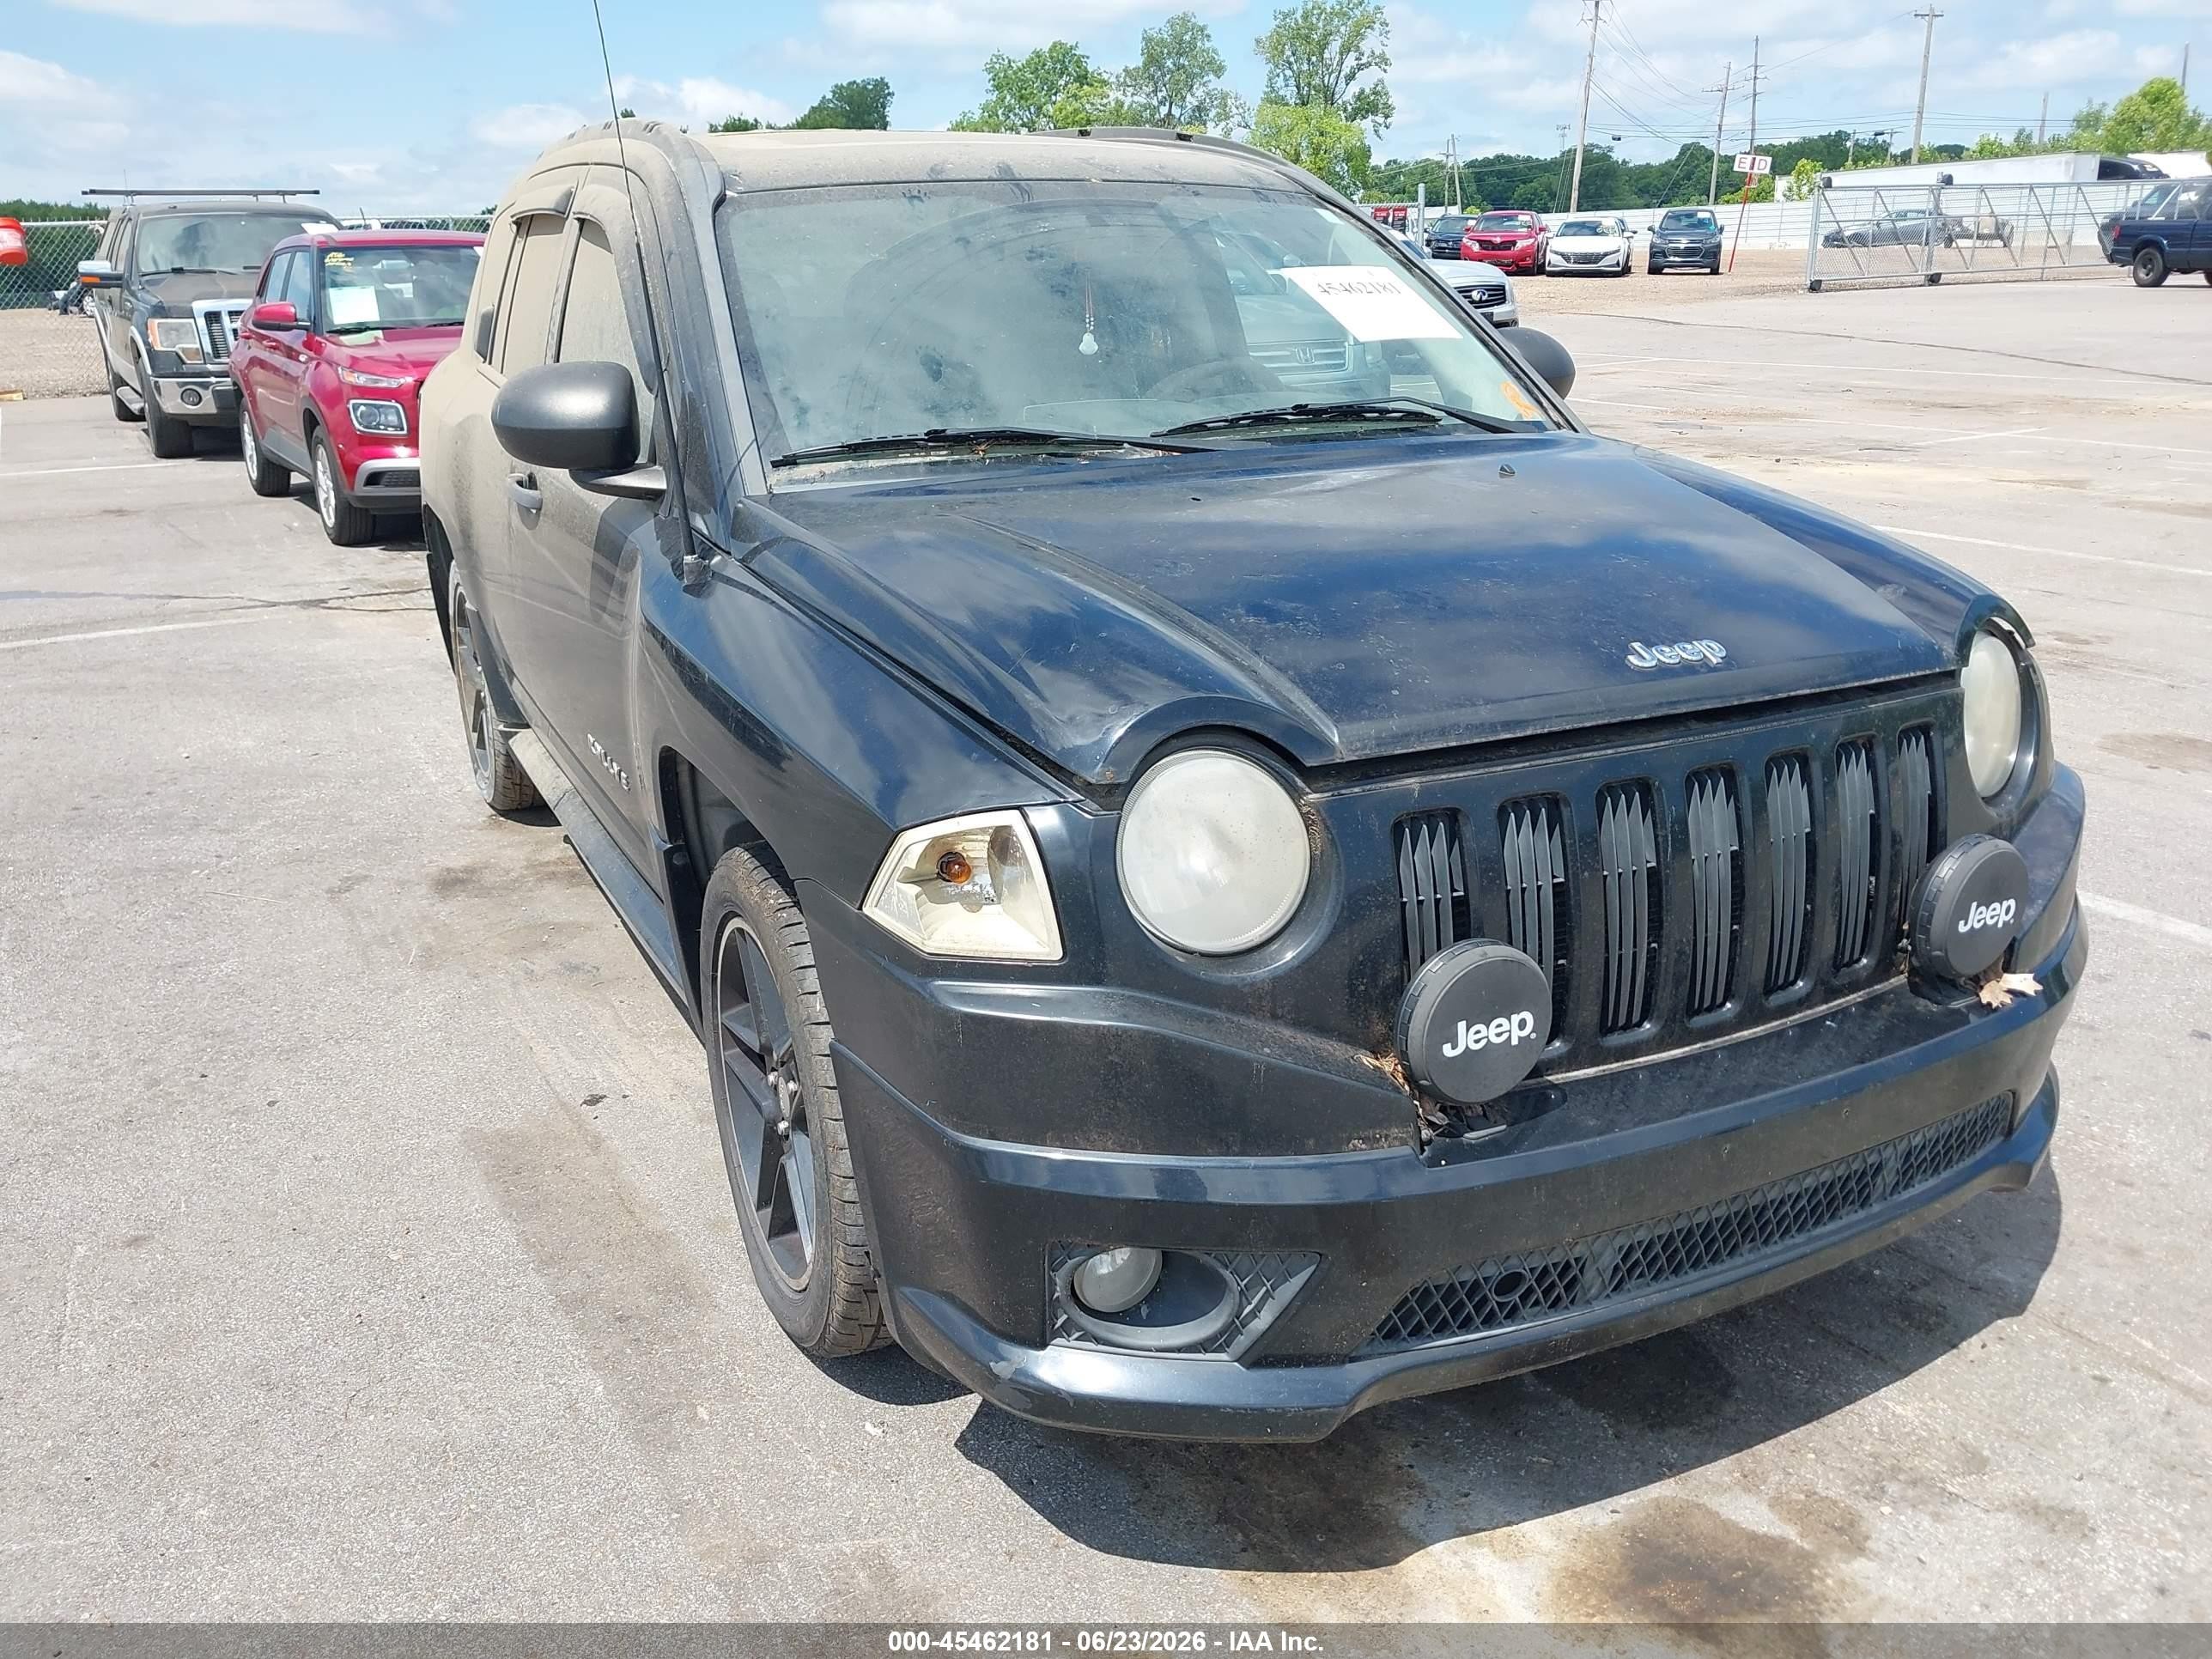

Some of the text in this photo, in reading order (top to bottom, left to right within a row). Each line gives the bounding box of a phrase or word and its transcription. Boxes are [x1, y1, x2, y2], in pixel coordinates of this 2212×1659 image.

[1626, 639, 1727, 668] Jeep
[1958, 898, 2016, 933] Jeep
[1442, 1011, 1534, 1058] Jeep
